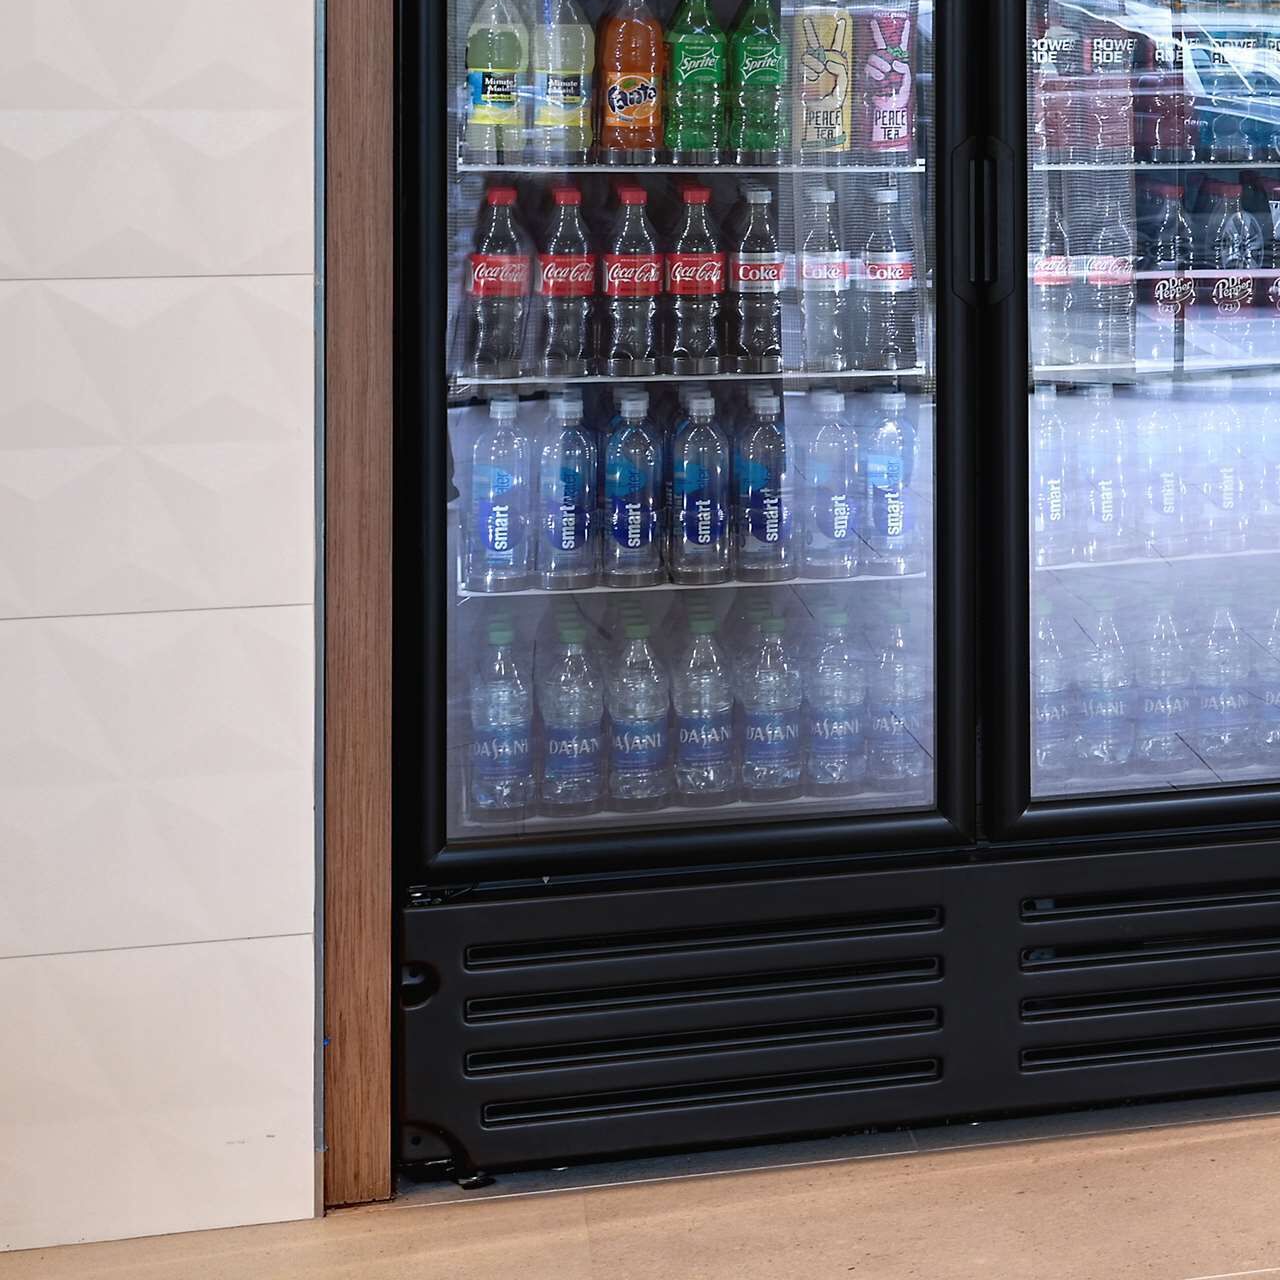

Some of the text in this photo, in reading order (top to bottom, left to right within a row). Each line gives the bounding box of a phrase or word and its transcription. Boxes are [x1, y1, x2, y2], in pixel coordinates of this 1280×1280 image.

[681, 56, 716, 69] Sprite
[743, 56, 776, 69] Sprite
[1093, 50, 1123, 63] ADE
[485, 78, 514, 87] Minute
[608, 83, 657, 113] Fanta
[808, 110, 841, 126] PEACE
[875, 110, 907, 126] PEACE
[816, 129, 834, 139] TEA
[883, 129, 900, 139] TEA
[739, 264, 777, 280] Coke
[803, 264, 841, 280] Coke
[867, 264, 904, 279] Coke
[1154, 281, 1192, 299] Pepper
[1170, 277, 1183, 287] Dr
[1215, 279, 1251, 298] Pepper
[1229, 276, 1243, 286] Dr
[1160, 472, 1174, 513] smart
[1220, 468, 1234, 509] smart
[1048, 480, 1061, 521] smart
[1099, 480, 1113, 522] smart
[696, 500, 711, 543] smart
[764, 497, 779, 542] smart
[832, 494, 848, 538] smart
[885, 492, 902, 536] smart
[493, 505, 509, 550] smart
[560, 505, 576, 550] smart
[628, 503, 641, 548] smart
